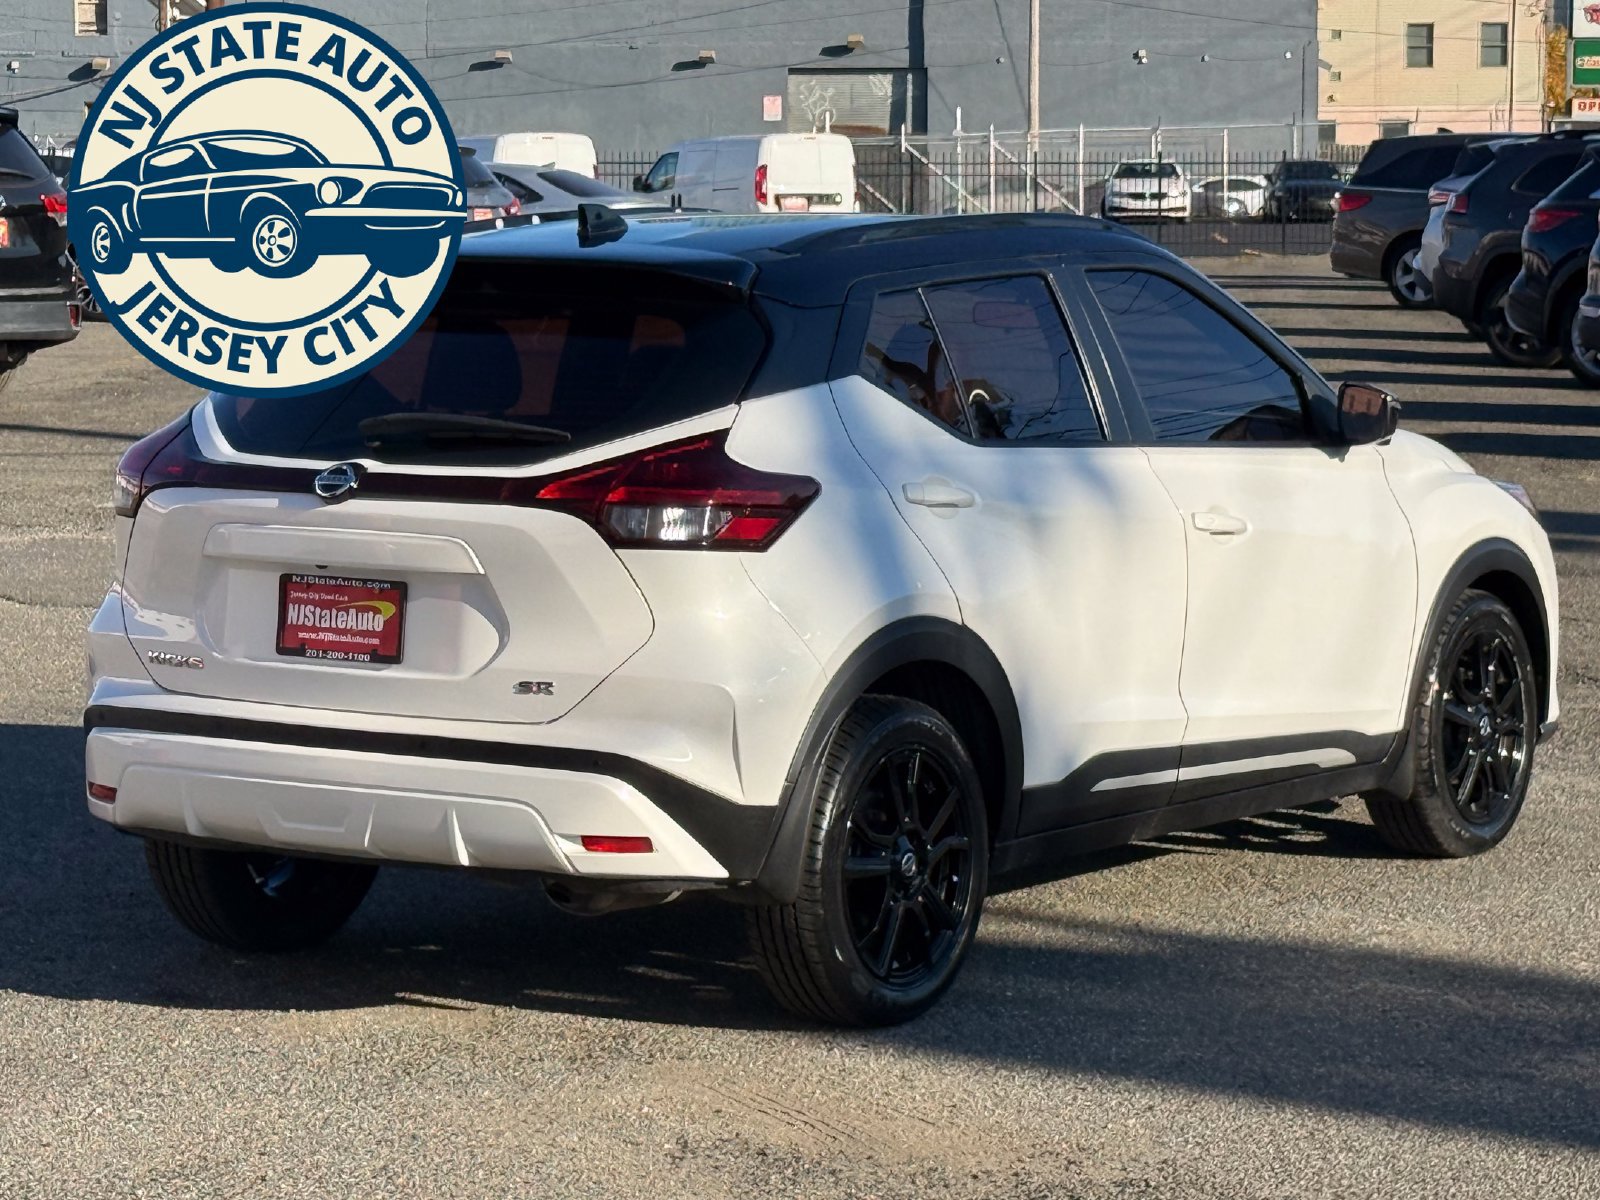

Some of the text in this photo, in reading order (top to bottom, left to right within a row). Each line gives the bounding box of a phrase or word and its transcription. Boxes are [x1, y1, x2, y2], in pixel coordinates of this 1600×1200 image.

[292, 575, 391, 589] NJStateAuto.com
[287, 602, 384, 632] NJStateAuto
[147, 650, 205, 669] KICKS
[305, 649, 371, 662] 201-200-1100
[512, 680, 555, 696] SR
